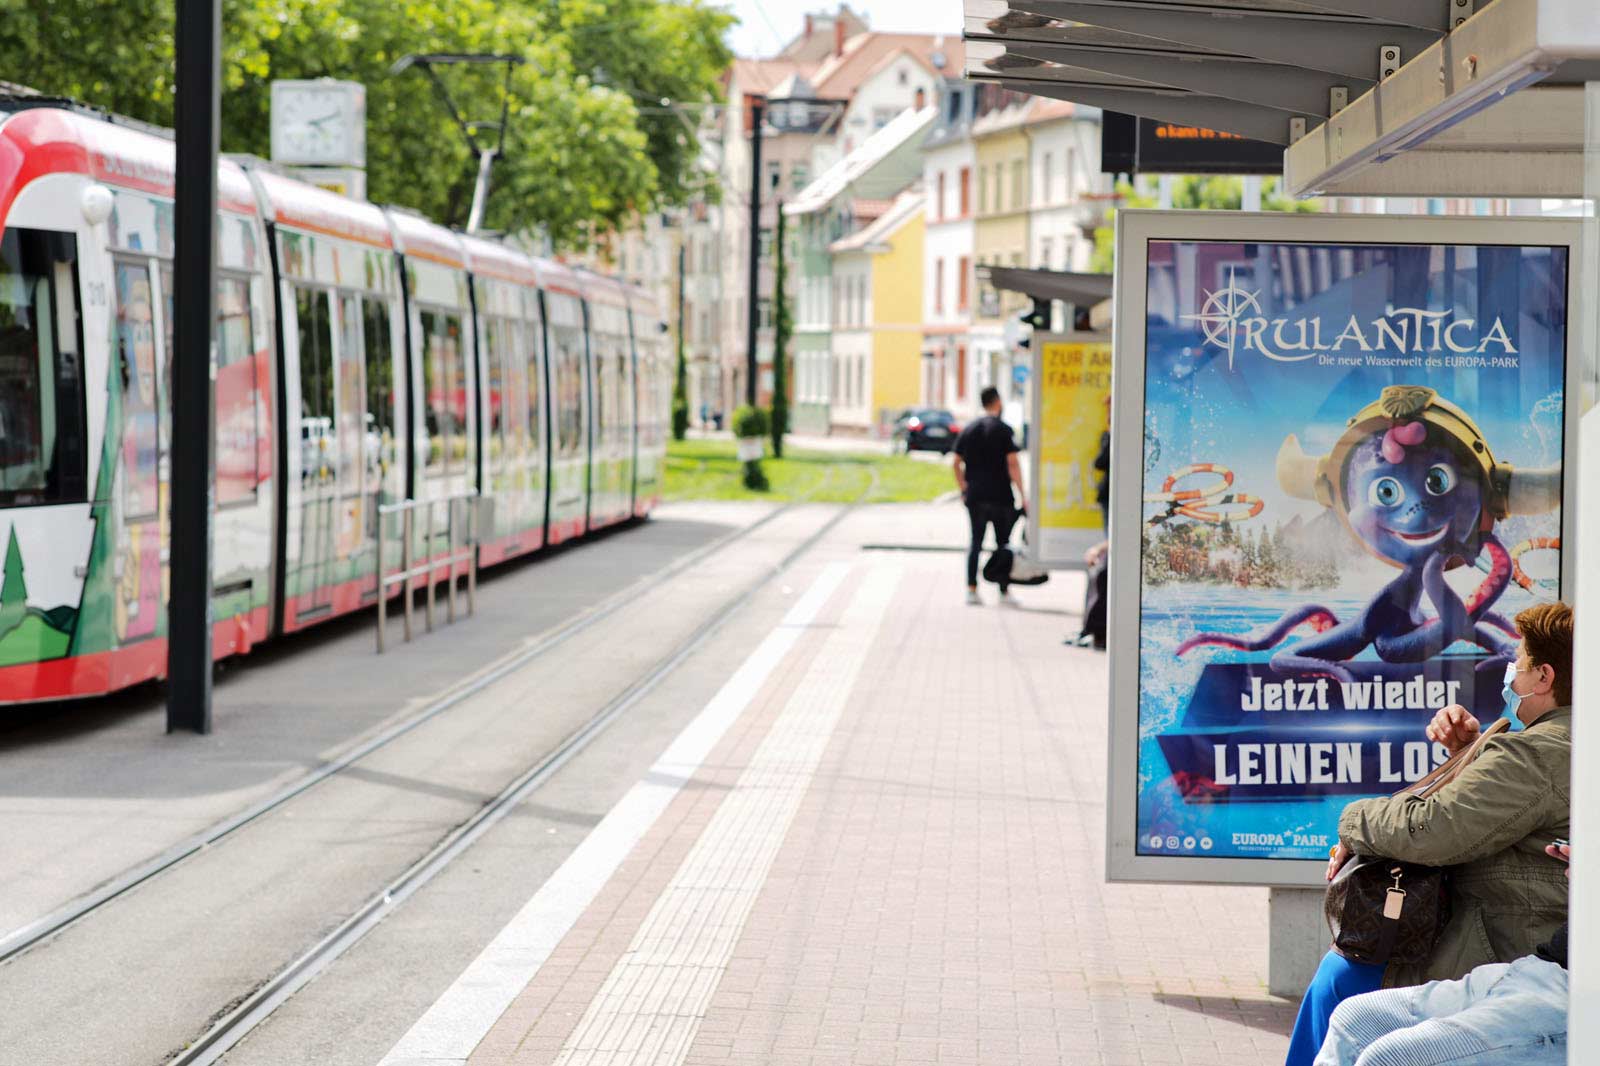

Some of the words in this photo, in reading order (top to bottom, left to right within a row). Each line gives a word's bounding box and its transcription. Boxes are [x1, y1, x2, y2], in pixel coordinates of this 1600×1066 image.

[1239, 308, 1518, 362] RULANTICA
[1050, 350, 1084, 367] ZUR
[1318, 355, 1336, 367] Die
[1338, 356, 1363, 367] neue
[1365, 355, 1423, 368] Wasserwelt
[1425, 355, 1443, 368] des
[1445, 356, 1519, 369] EUROPA-PARK
[1241, 676, 1329, 712] Jetzt
[1341, 674, 1461, 710] wieder
[1213, 742, 1363, 785] LEINEN
[1231, 832, 1285, 846] EUROPA
[1293, 834, 1328, 847] PARK
